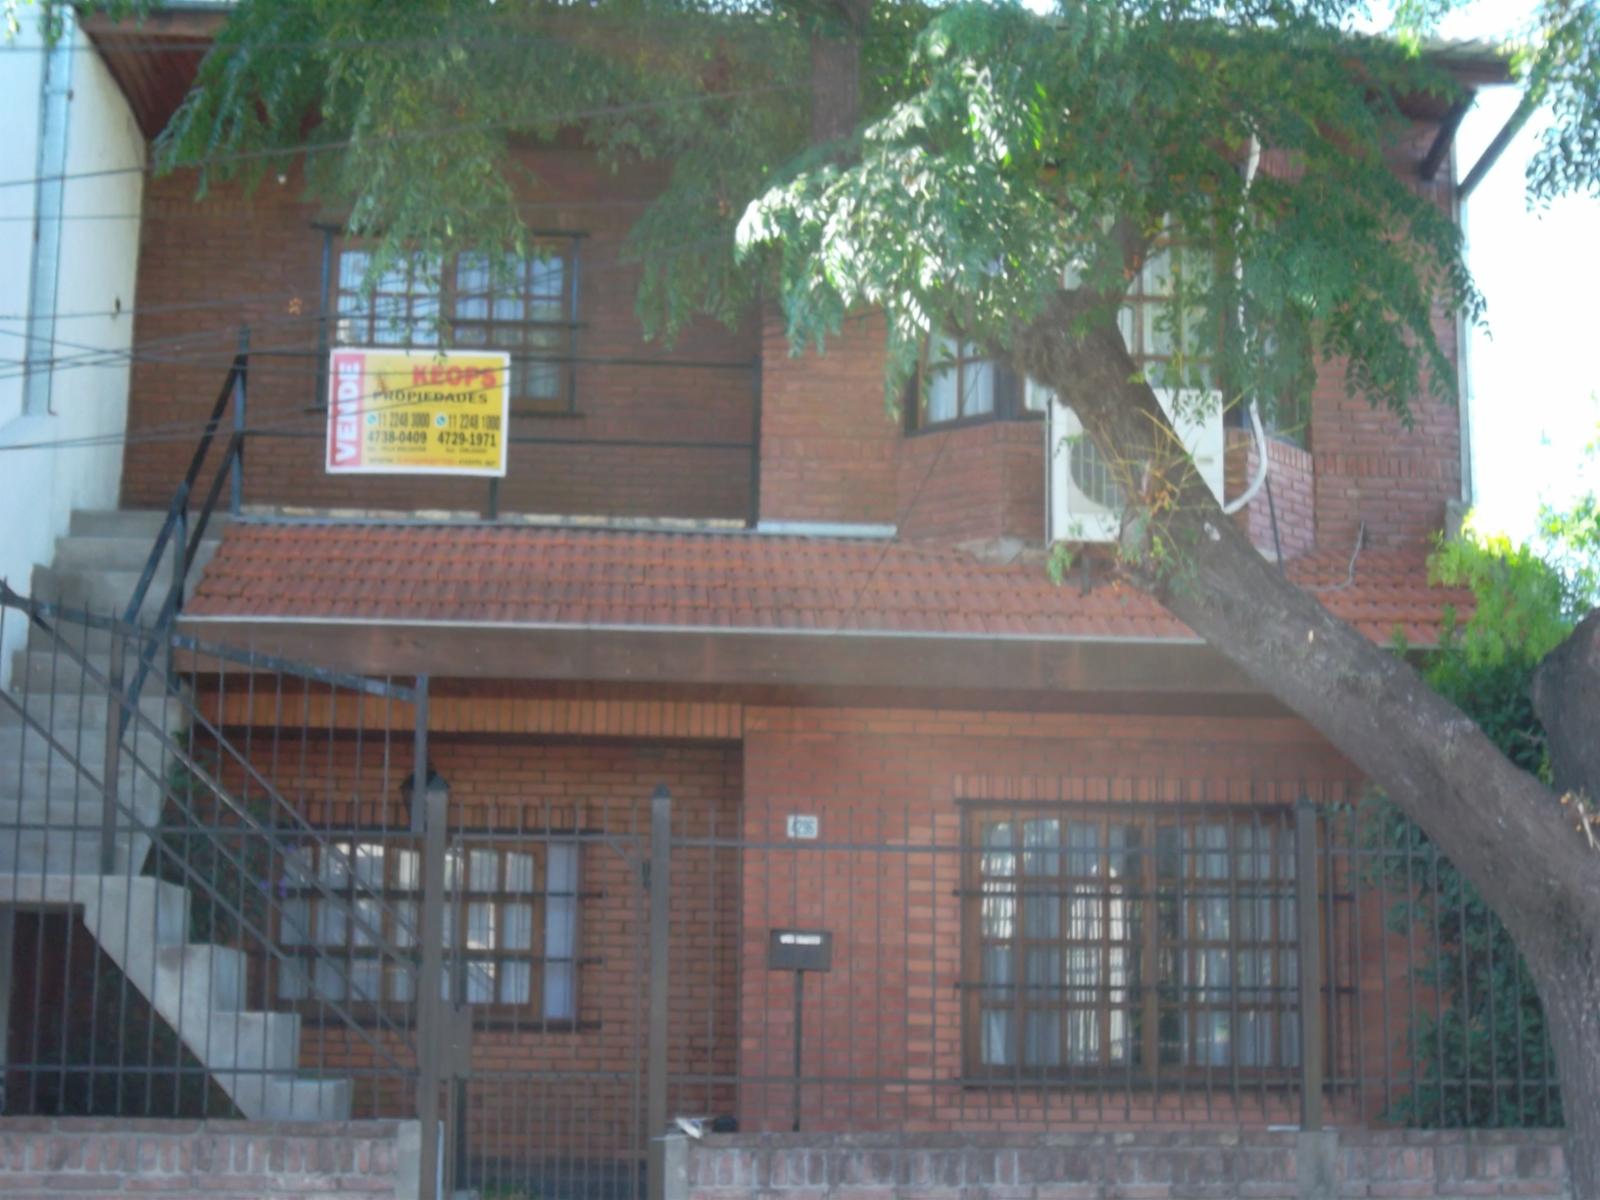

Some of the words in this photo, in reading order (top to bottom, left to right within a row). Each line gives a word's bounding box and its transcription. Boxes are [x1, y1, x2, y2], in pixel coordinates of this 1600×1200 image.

[412, 364, 496, 389] KEOPS
[373, 390, 487, 404] PROPIEDADES
[335, 361, 360, 462] VENDE
[438, 431, 496, 447] 4729-1971
